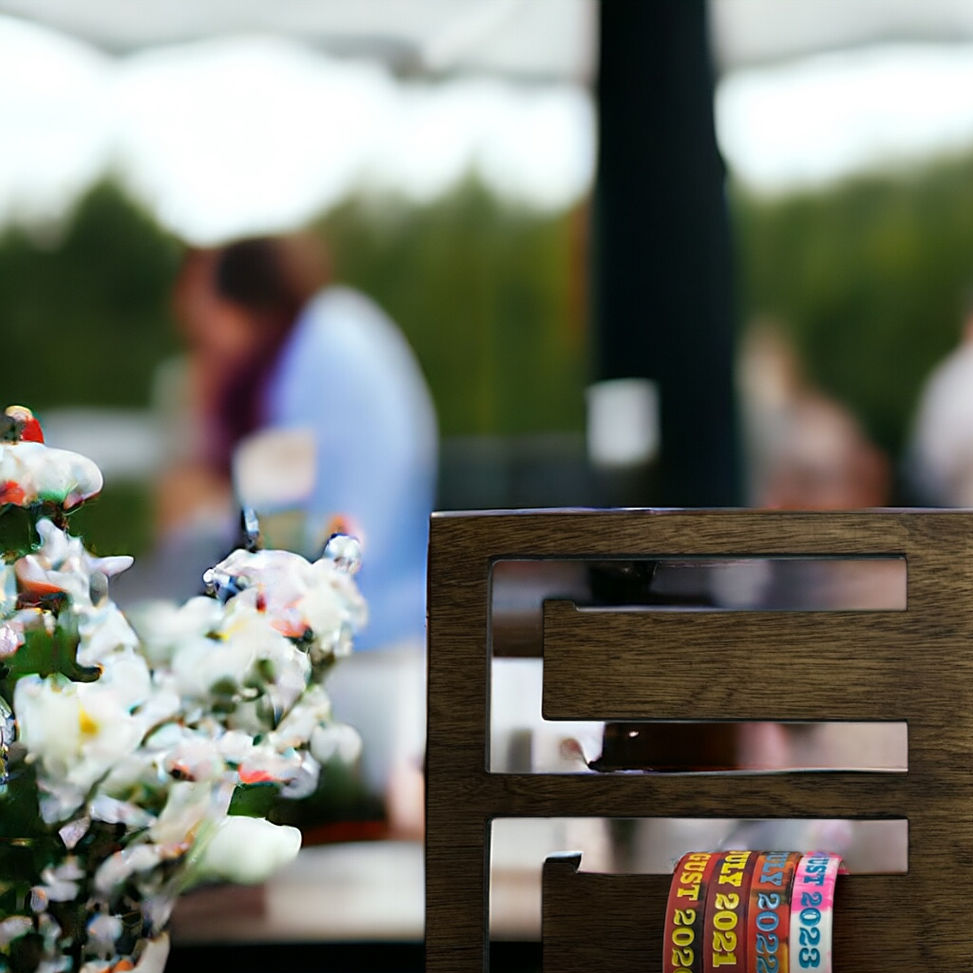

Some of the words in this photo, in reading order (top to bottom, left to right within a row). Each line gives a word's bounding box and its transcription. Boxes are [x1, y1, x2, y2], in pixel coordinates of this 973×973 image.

[803, 855, 830, 887] UST
[712, 892, 740, 968] 2021
[798, 891, 823, 969] 2023
